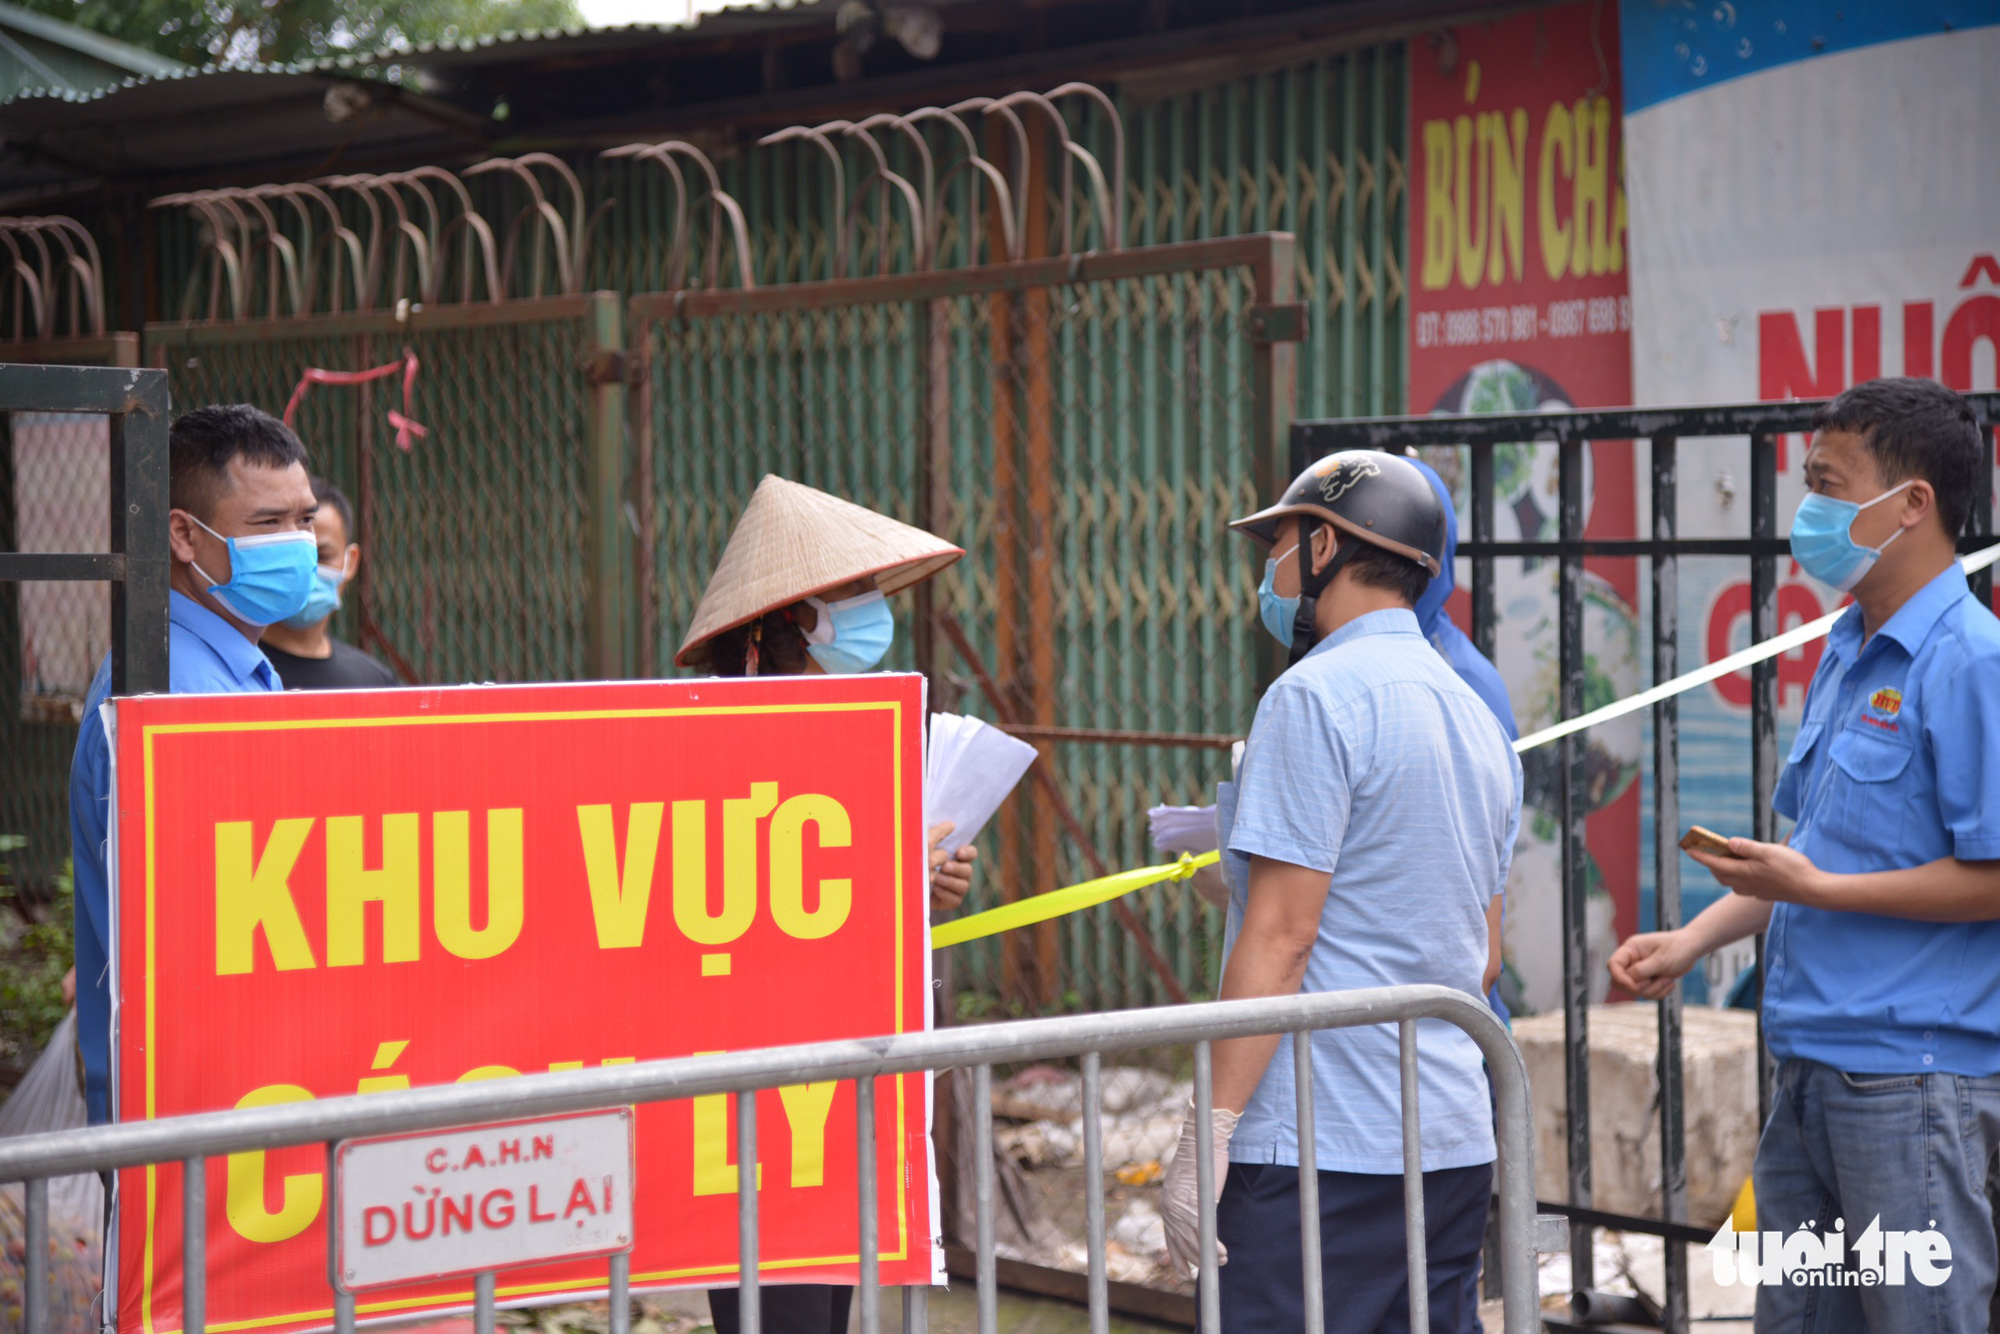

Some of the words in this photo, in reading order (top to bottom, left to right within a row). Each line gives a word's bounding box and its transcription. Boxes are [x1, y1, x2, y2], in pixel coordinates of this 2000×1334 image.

[1421, 60, 1528, 291] BÚN
[214, 808, 524, 975] KHU
[577, 781, 853, 977] VỰC
[362, 1185, 516, 1248] DỪNG
[528, 1175, 614, 1229] LẠI
[425, 1134, 554, 1174] C.A.H.N
